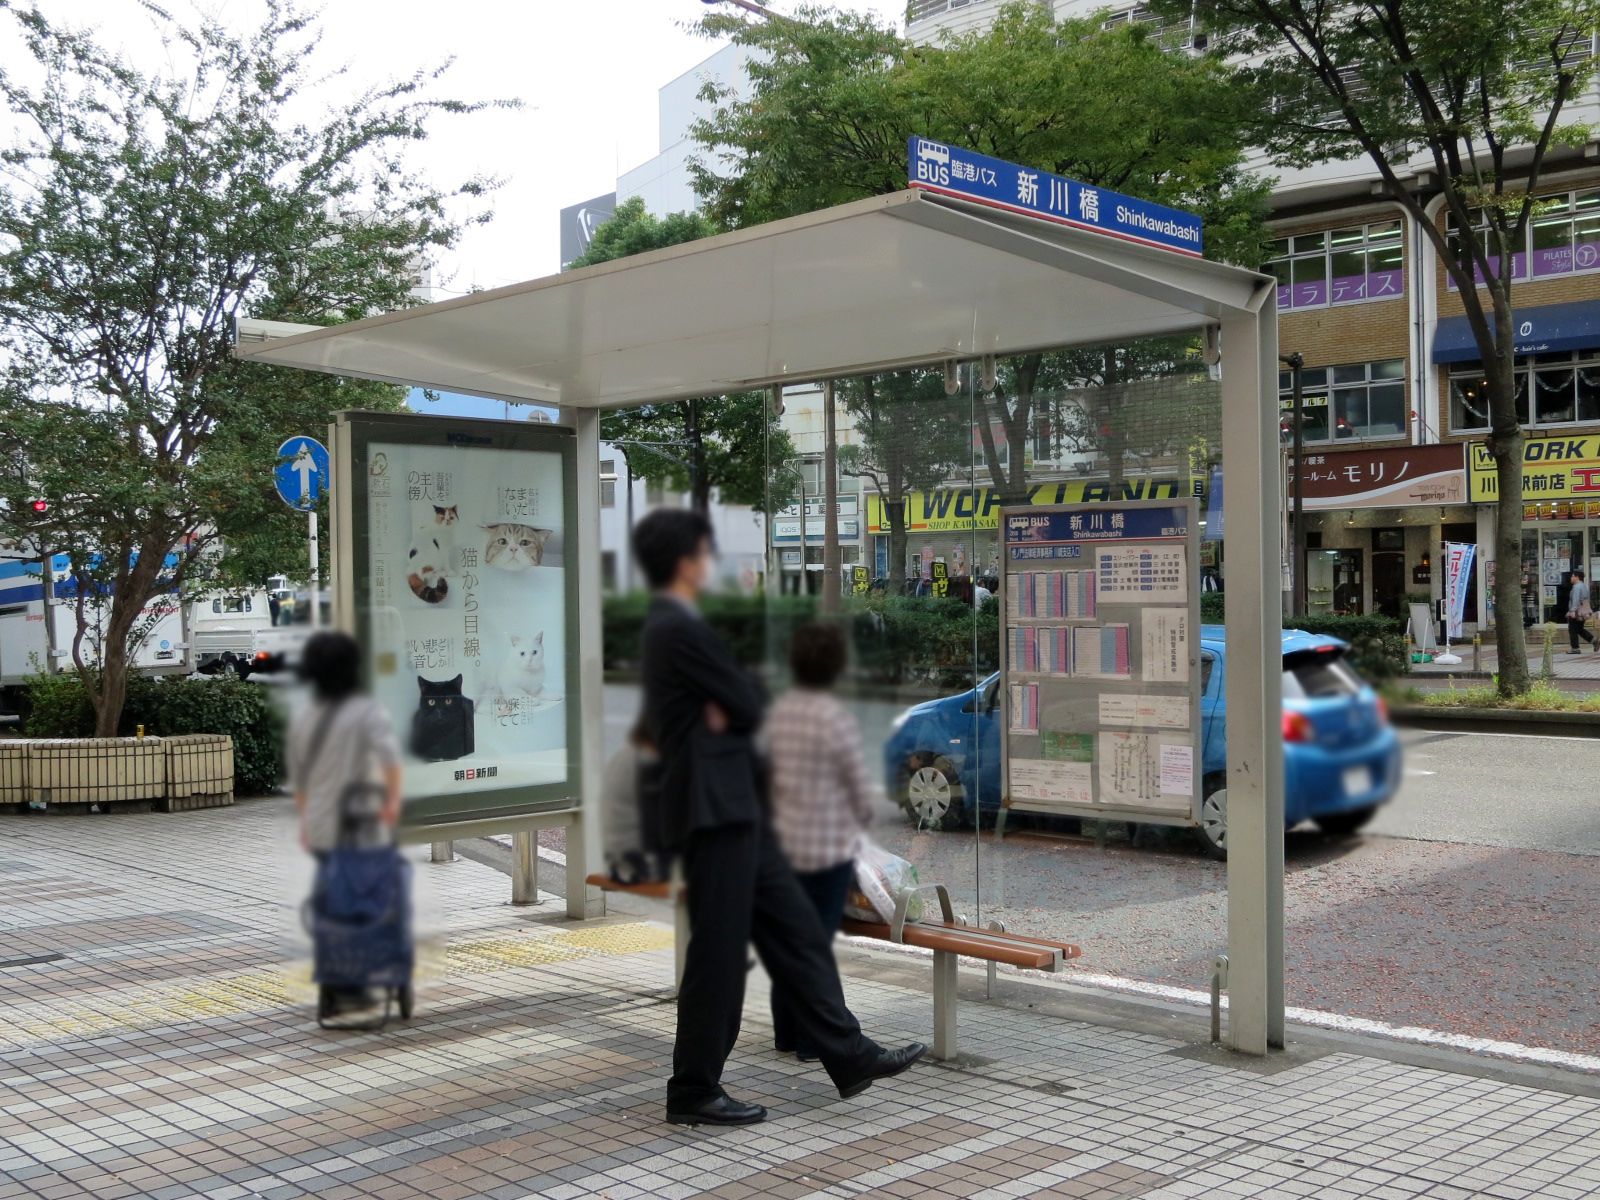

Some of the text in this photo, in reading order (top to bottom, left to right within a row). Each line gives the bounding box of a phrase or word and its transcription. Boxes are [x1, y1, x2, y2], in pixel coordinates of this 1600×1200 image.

[917, 160, 950, 186] BUS
[951, 160, 998, 188] 臨港バス
[1017, 169, 1100, 223] 新川橋
[1115, 205, 1199, 243] Shinkawabashi
[1543, 249, 1572, 260] PILATES
[1277, 274, 1396, 308] ピラティス
[1287, 471, 1337, 483] テールーム
[1342, 461, 1409, 483] モリノ
[419, 471, 433, 501] 主人
[517, 487, 528, 516] まだ
[928, 519, 1000, 530] SHOP KAWASAK
[1030, 516, 1050, 527] BUS
[1069, 513, 1125, 531] 新川橋
[1073, 530, 1123, 539] Shinkawabashi
[461, 546, 481, 668] 猫から目線。
[455, 766, 498, 781] 朝日新聞
